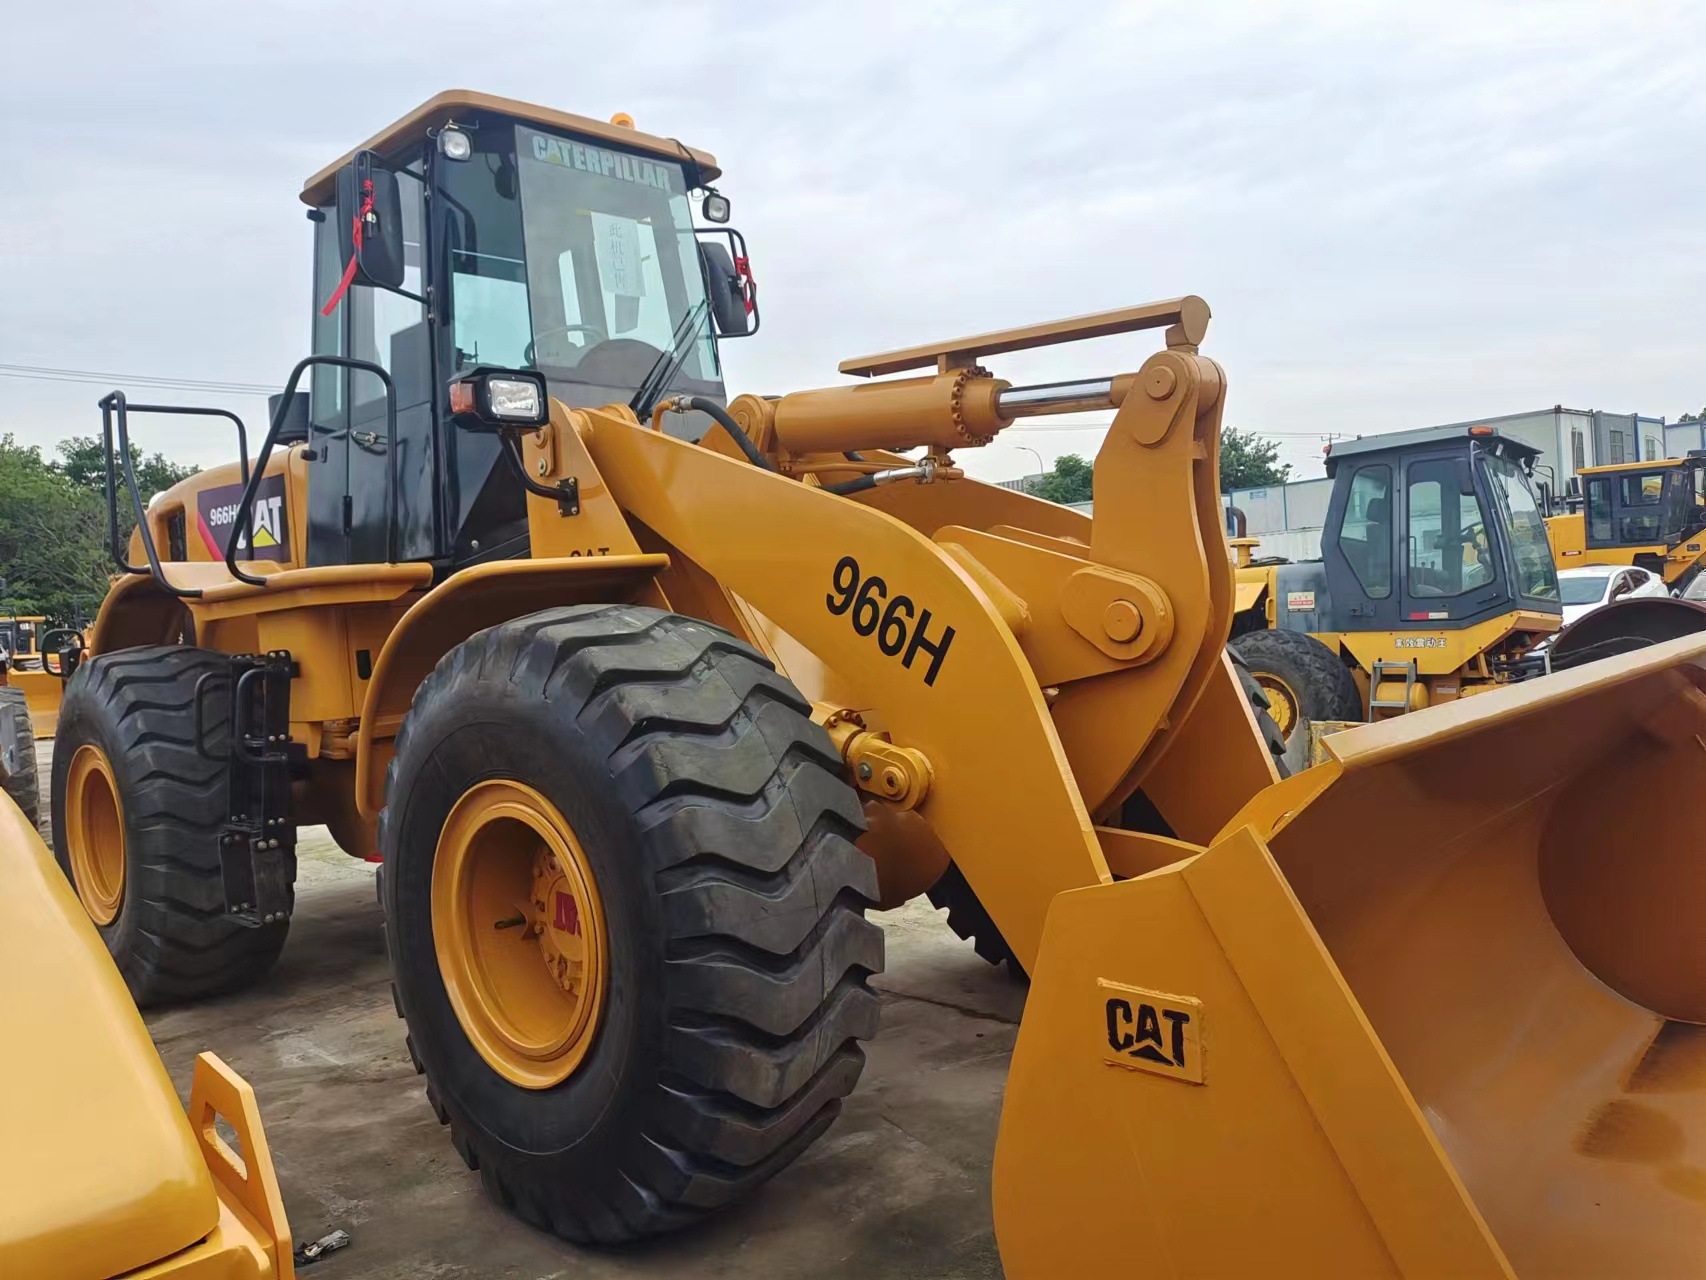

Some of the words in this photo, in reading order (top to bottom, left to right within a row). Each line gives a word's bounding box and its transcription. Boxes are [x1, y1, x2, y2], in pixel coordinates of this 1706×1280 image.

[532, 136, 671, 192] CATERPILLAR
[210, 504, 238, 526] 966H
[826, 556, 956, 687] 966H
[1106, 998, 1190, 1068] CAT
